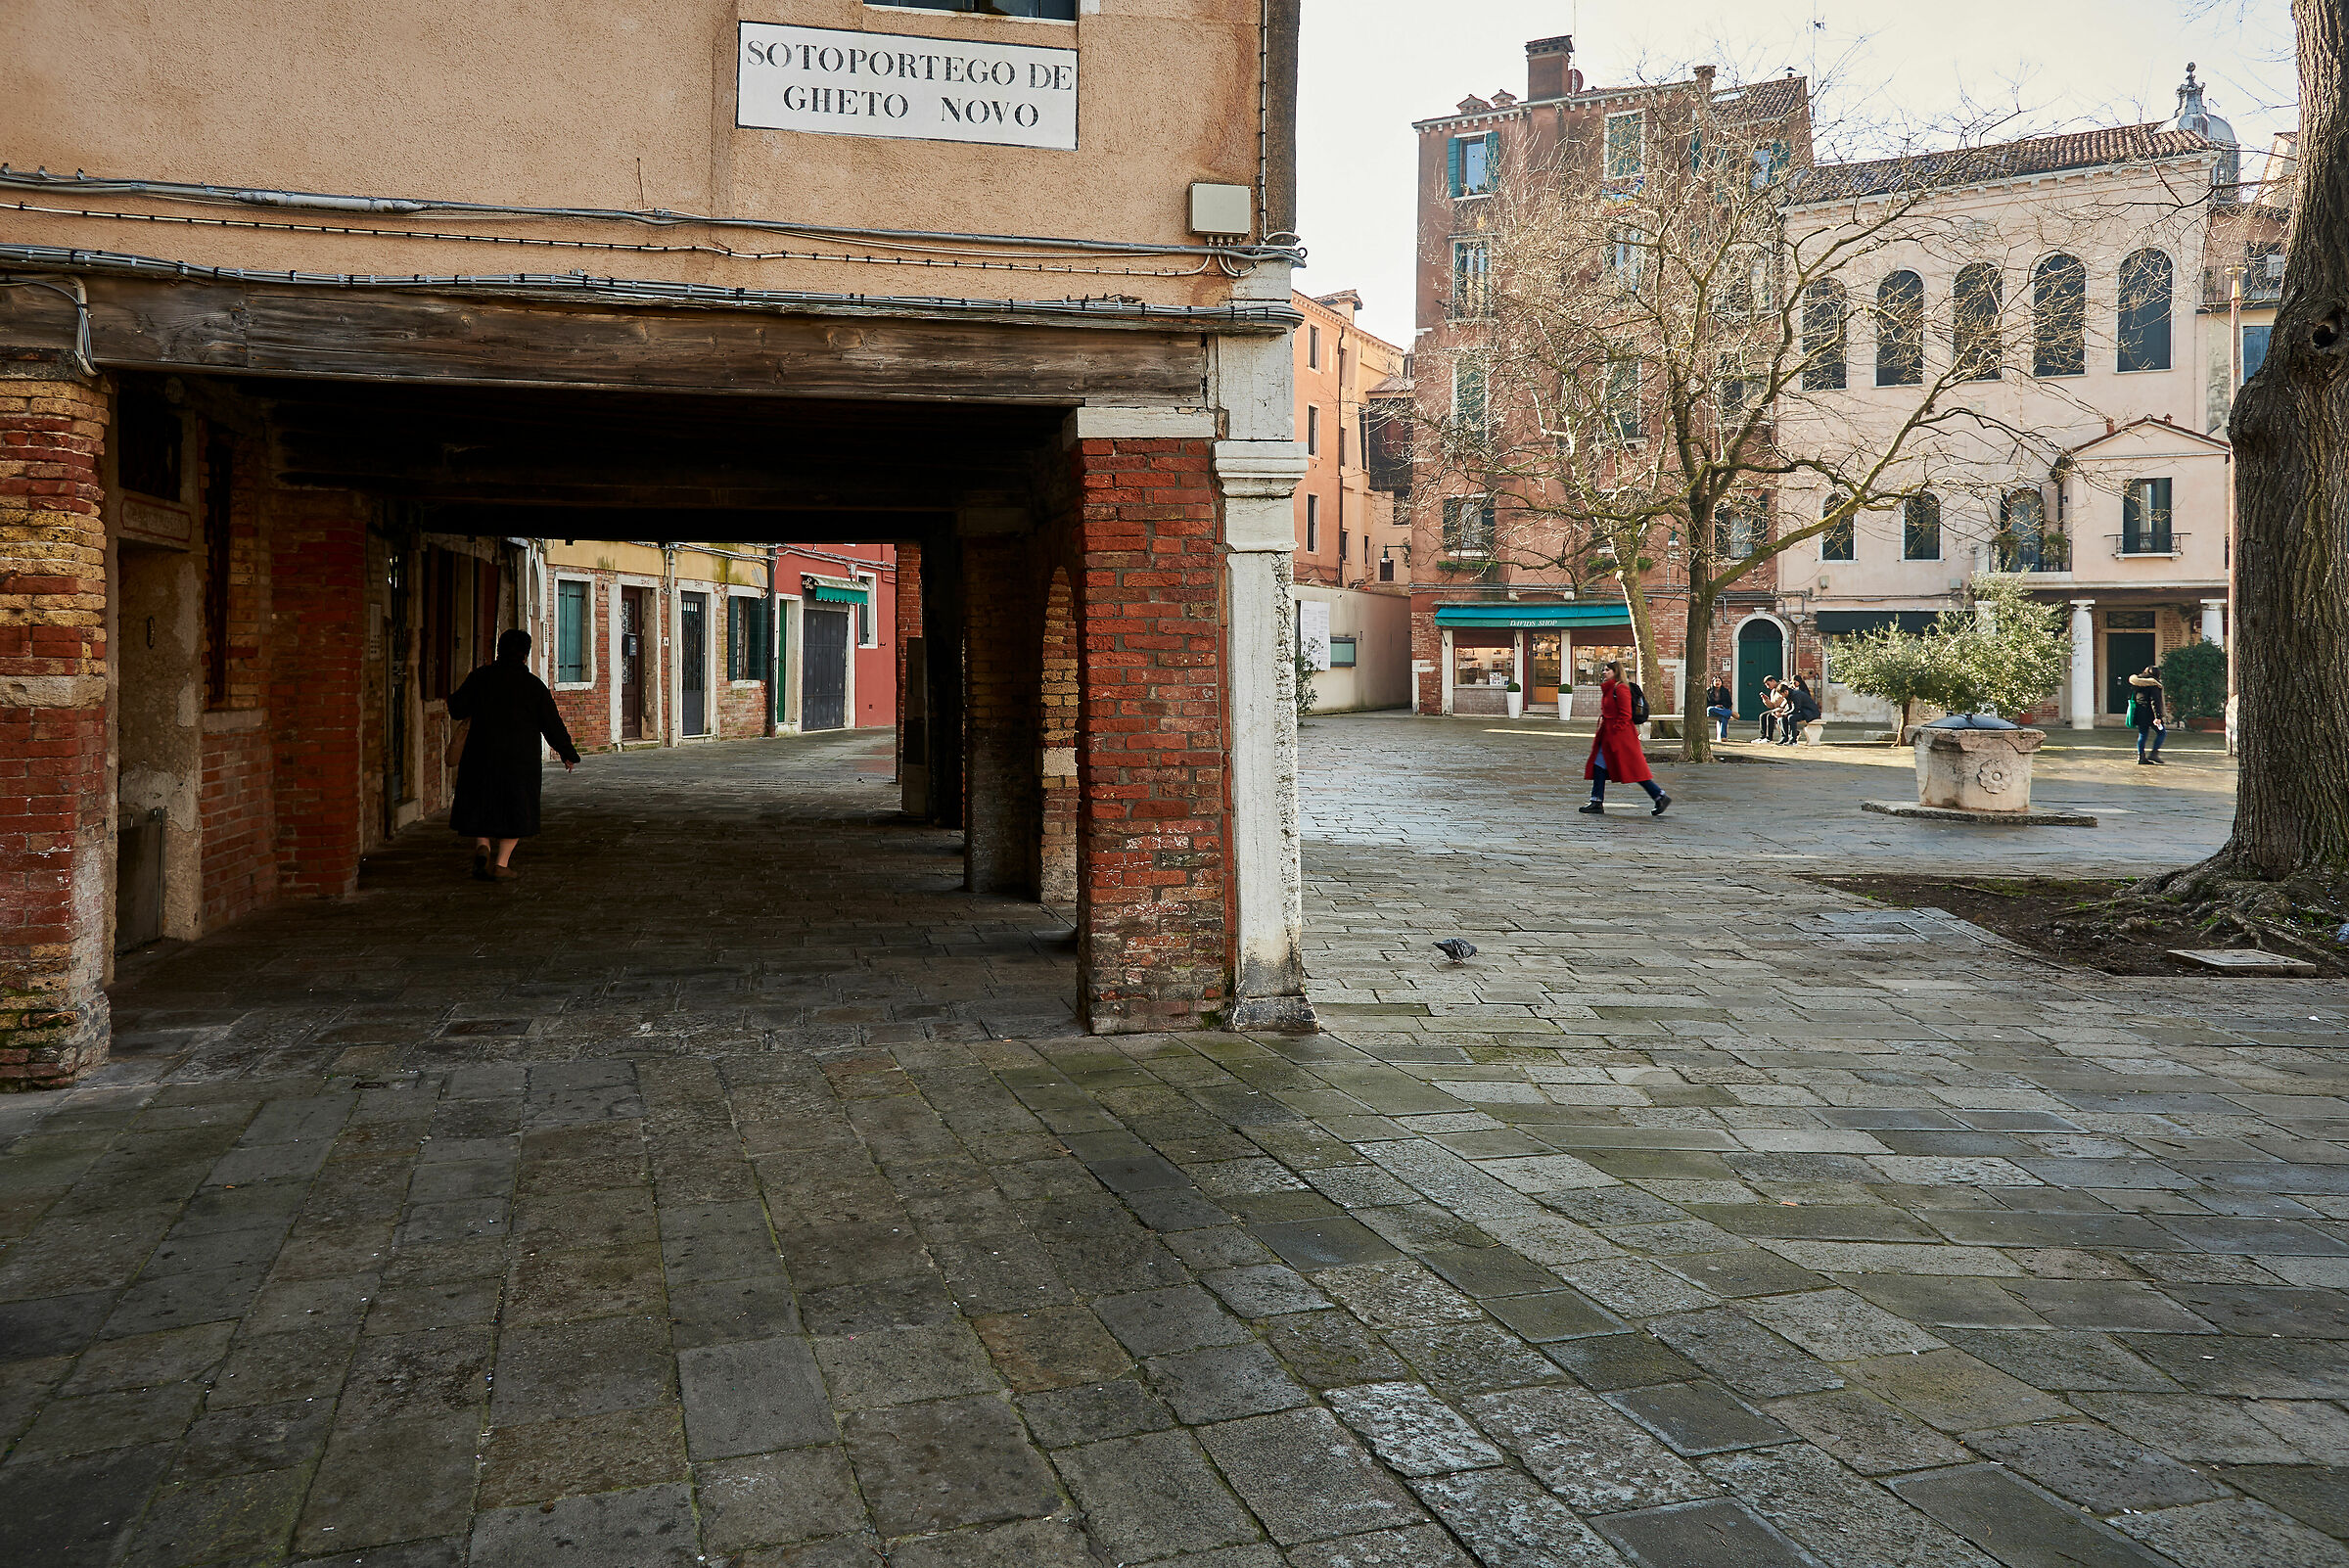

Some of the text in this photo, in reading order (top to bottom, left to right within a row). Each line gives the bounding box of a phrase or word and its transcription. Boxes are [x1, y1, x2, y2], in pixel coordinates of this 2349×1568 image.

[747, 40, 1073, 90] SOTOPORTEGO DE
[783, 85, 1039, 128] GHETO NOVO
